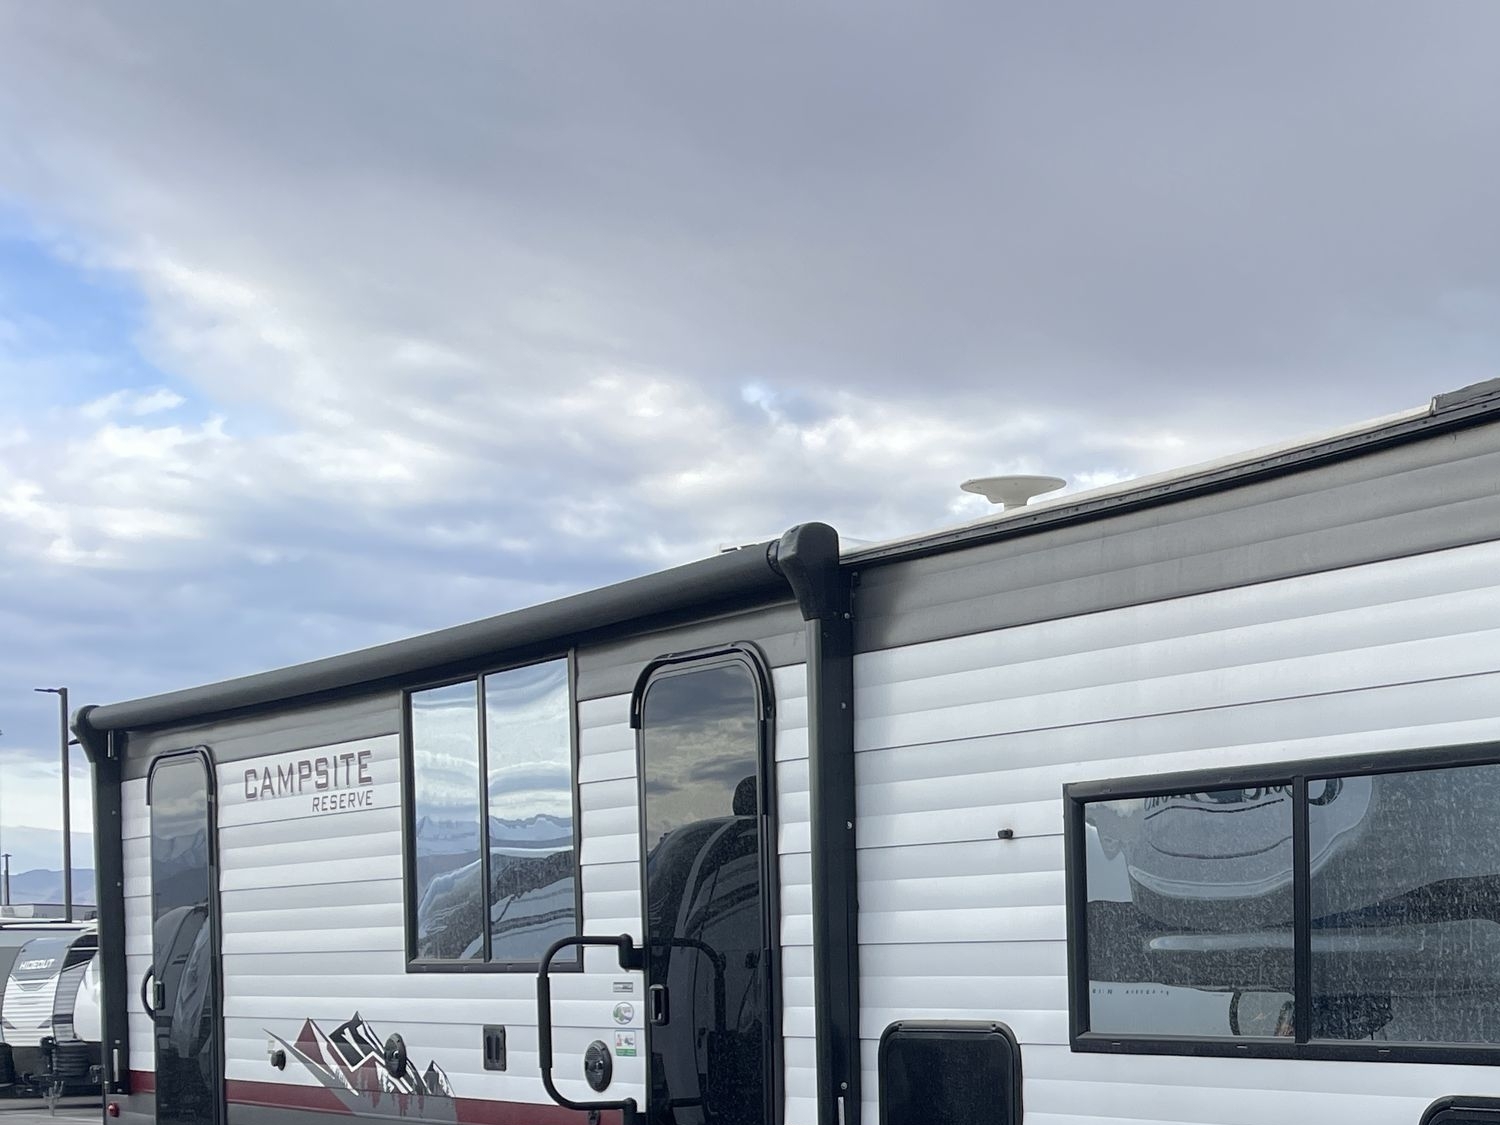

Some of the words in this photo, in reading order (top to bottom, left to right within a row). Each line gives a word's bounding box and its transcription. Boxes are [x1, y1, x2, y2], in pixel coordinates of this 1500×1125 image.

[244, 750, 373, 800] CAMPSITE
[312, 790, 374, 812] RESERVE
[19, 958, 56, 971] HIDEOUT
